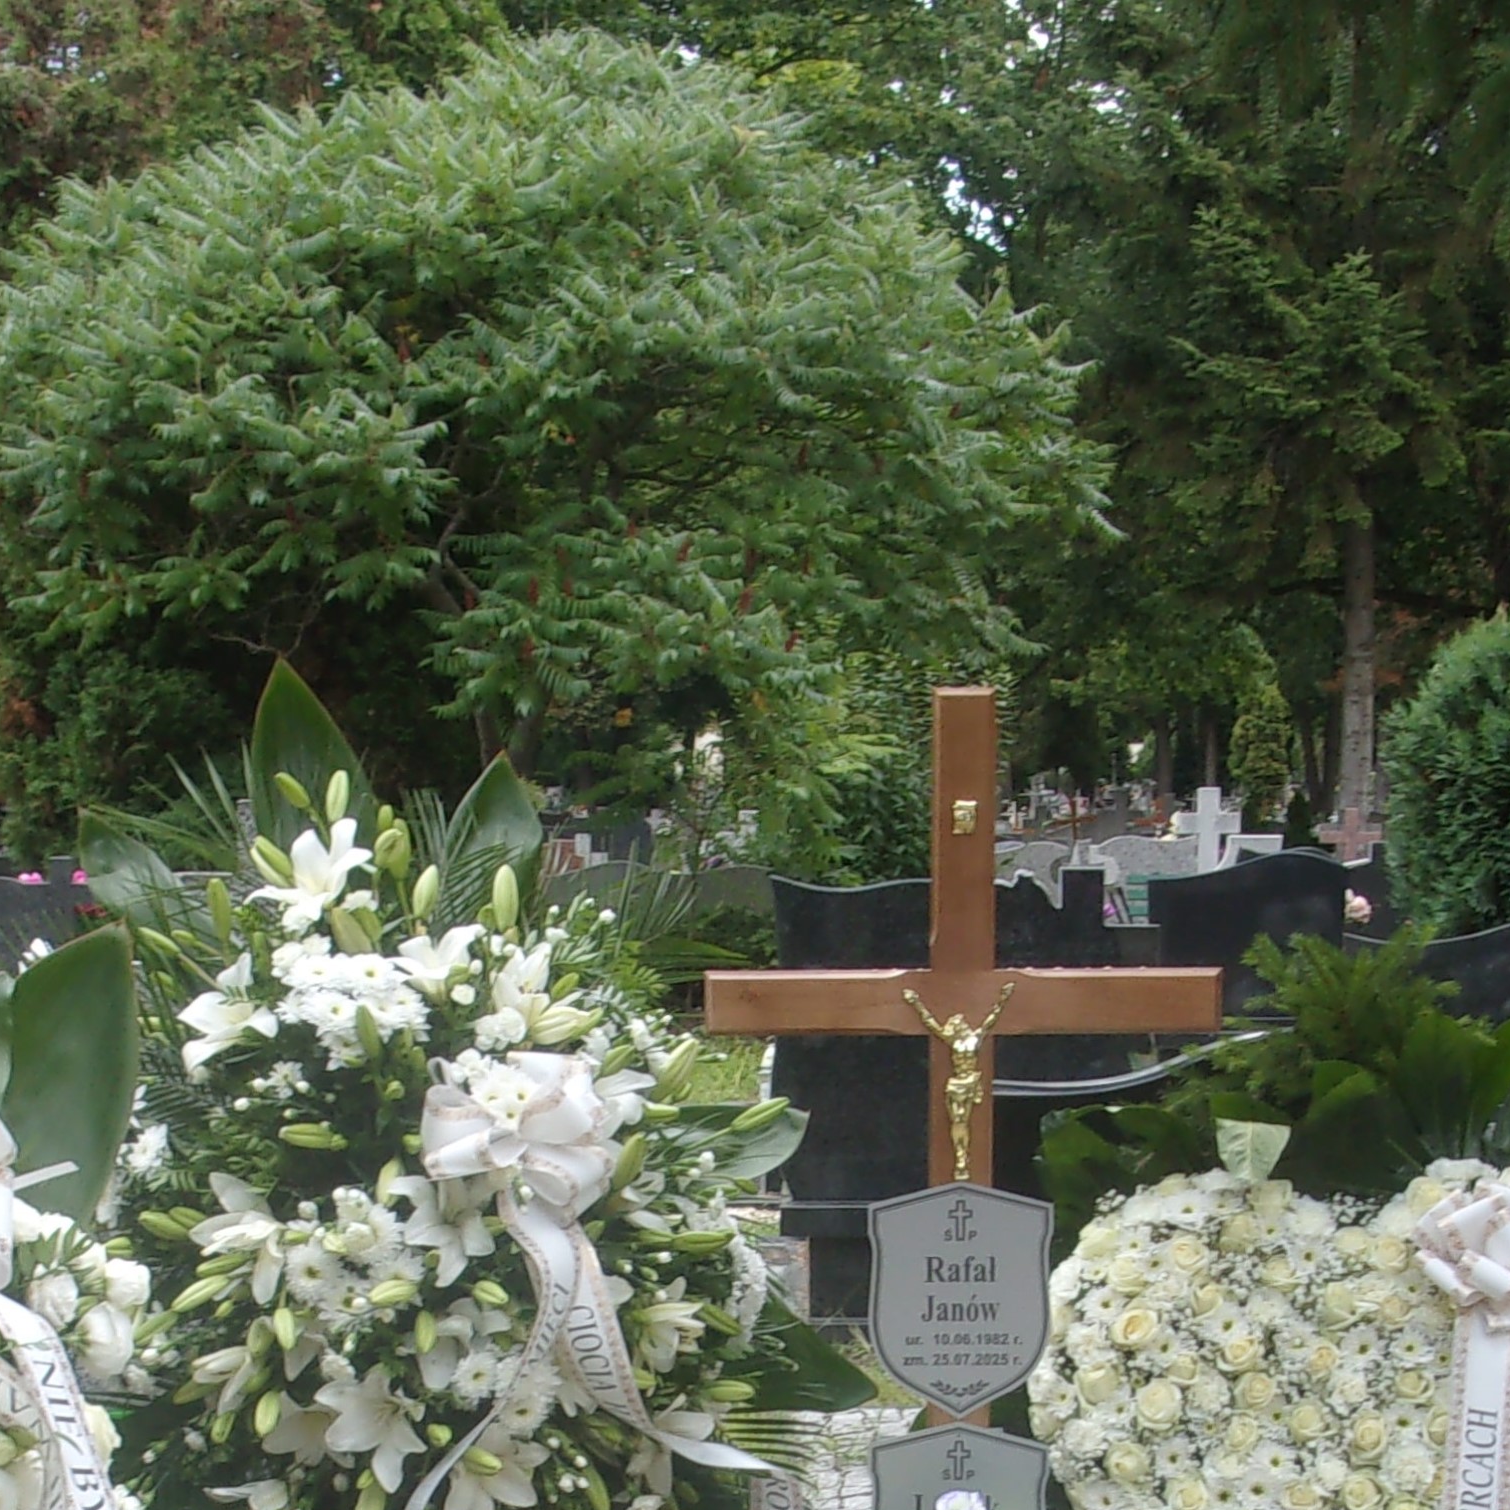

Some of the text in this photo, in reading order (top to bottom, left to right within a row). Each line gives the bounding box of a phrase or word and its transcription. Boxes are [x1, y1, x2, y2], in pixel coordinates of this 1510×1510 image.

[968, 1230, 978, 1241] P
[924, 1256, 996, 1283] Rafał
[921, 1294, 1000, 1322] Janów
[904, 1335, 924, 1346] ur.
[1013, 1335, 1023, 1346] r.
[902, 1352, 1023, 1367] zm. 25.07.2025 r.
[966, 1469, 976, 1481] P
